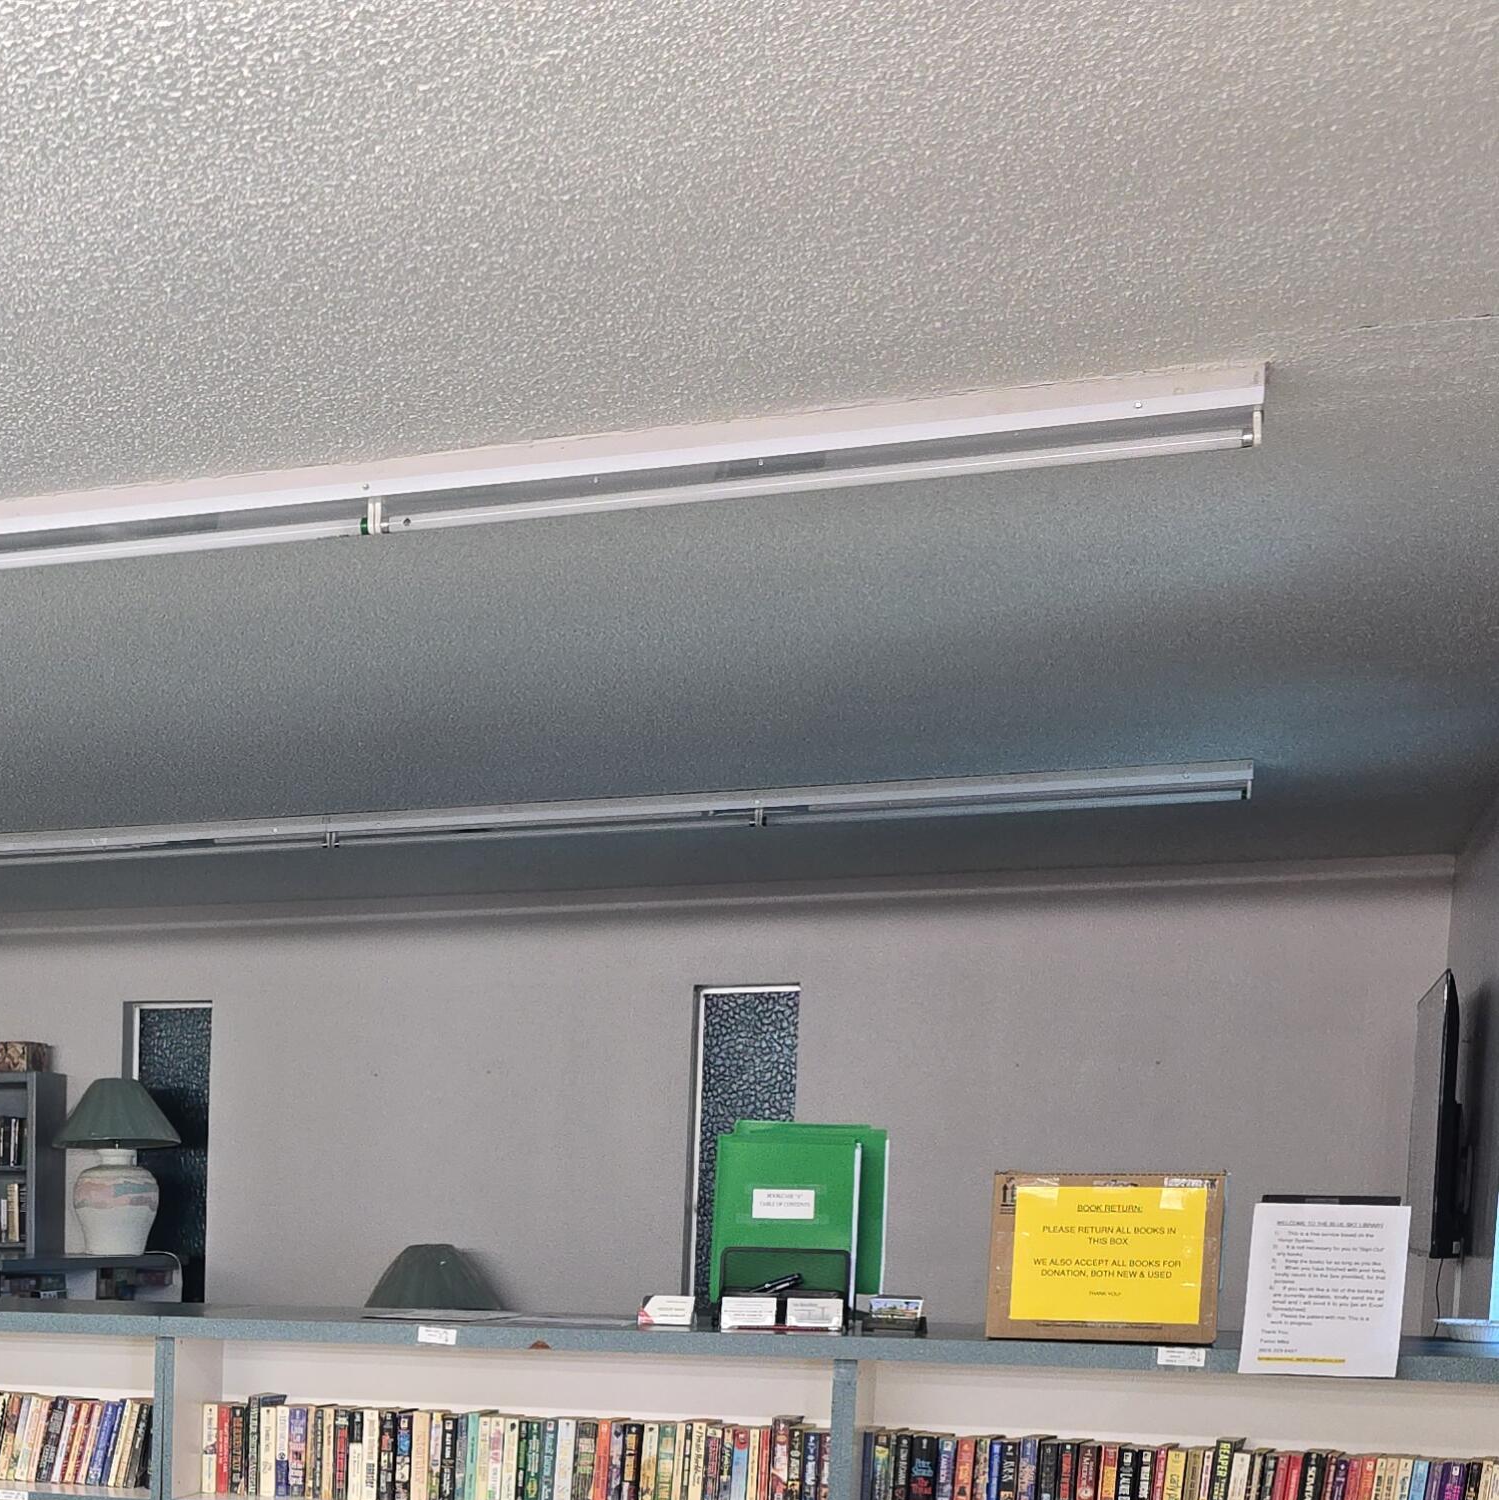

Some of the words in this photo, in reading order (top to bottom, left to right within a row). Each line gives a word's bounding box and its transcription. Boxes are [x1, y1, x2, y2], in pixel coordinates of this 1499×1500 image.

[1077, 1204, 1102, 1213] BOOK
[1078, 1226, 1113, 1234] RETURN
[1075, 1259, 1108, 1267] ACCEPT
[1041, 1270, 1088, 1278] DONATION,
[1091, 1270, 1115, 1278] BOTH
[1117, 1270, 1137, 1278] NEW
[1216, 1442, 1230, 1477] REAPER
